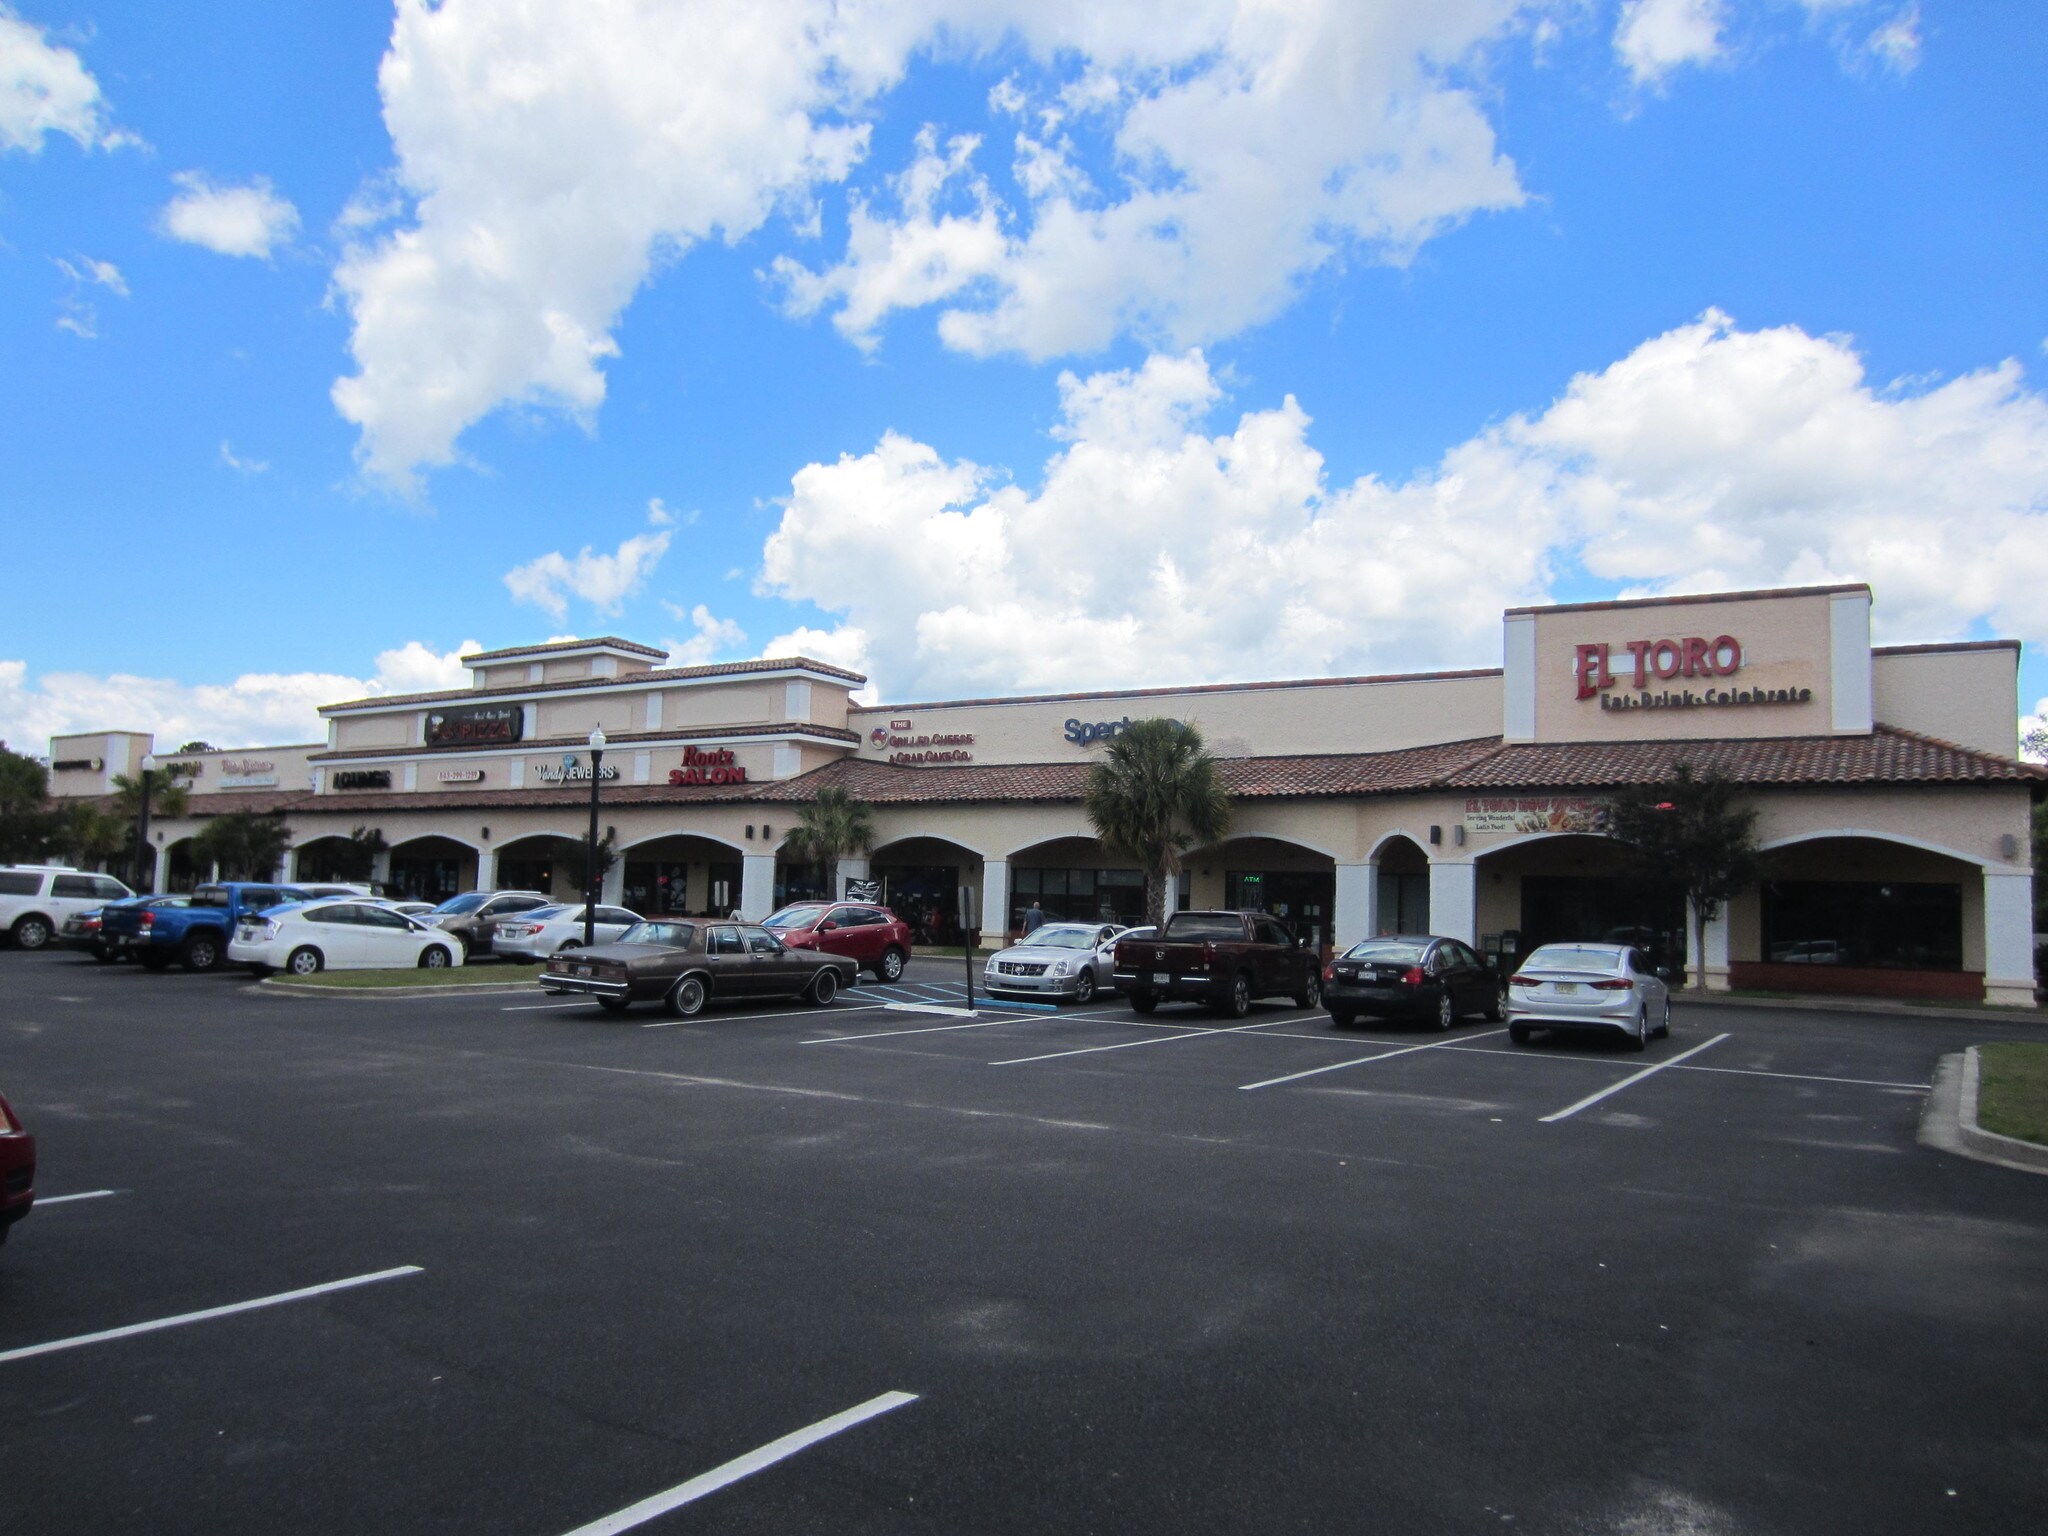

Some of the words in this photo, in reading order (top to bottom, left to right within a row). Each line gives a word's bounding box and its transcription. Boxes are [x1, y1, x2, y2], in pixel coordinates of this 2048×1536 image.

[1575, 643, 1615, 700] EL
[1627, 635, 1741, 688] TORO
[681, 744, 735, 767] Rootz
[333, 770, 391, 789] LOUNGE
[534, 764, 566, 785] Vandy
[669, 767, 746, 786] SALON
[1466, 815, 1487, 823] Serving
[1488, 814, 1516, 822] Wonderful
